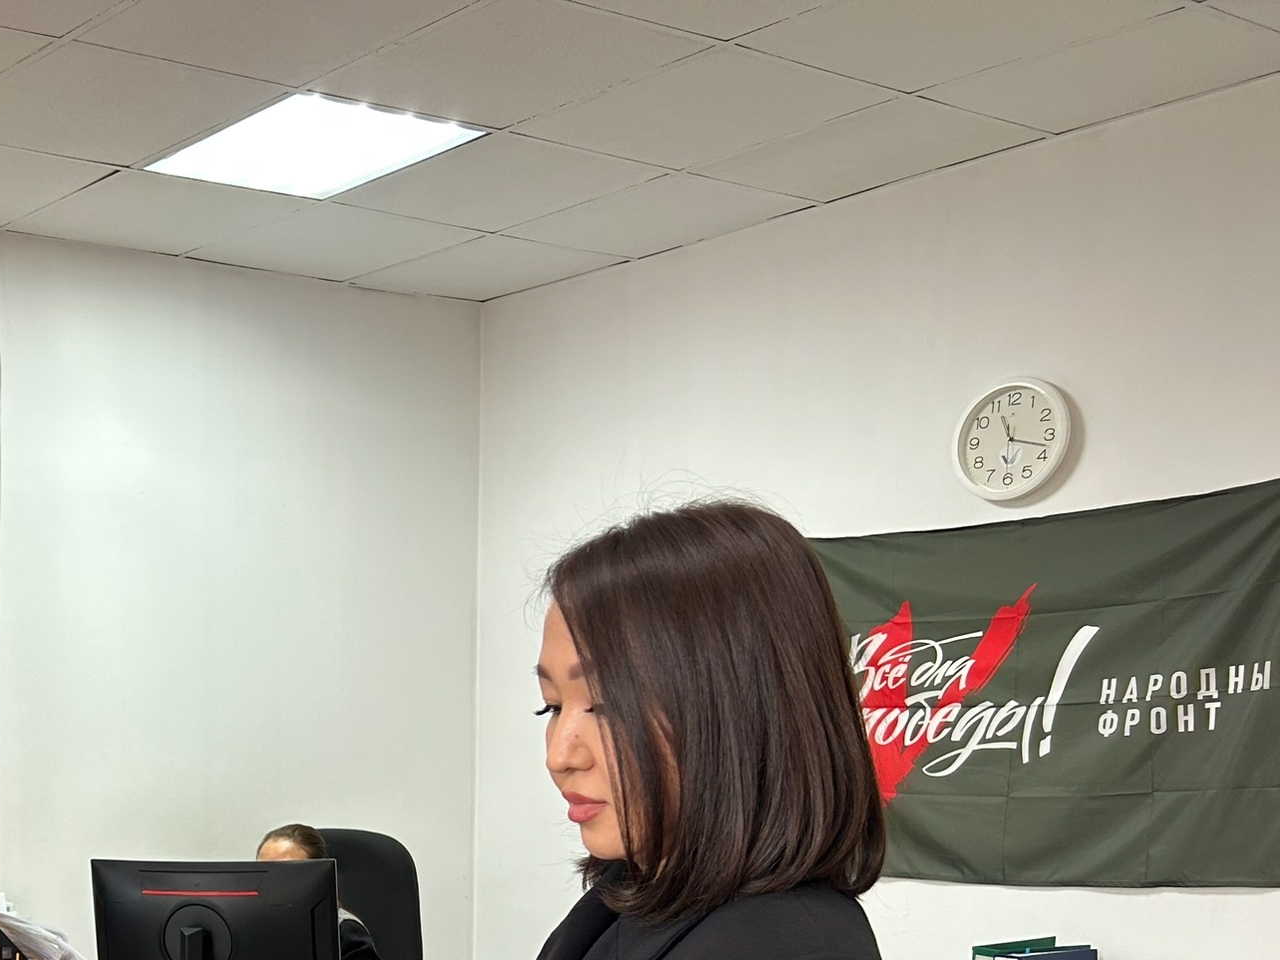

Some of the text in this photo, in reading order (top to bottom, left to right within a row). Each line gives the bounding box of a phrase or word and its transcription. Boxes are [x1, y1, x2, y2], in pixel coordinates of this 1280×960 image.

[1007, 392, 1022, 407] 12
[1031, 395, 1035, 408] 1
[991, 400, 1001, 414] 11
[1040, 408, 1051, 422] 2
[975, 416, 989, 430] 10
[1044, 428, 1055, 441] 3
[969, 437, 980, 450] 9
[973, 456, 984, 469] 8
[1037, 449, 1048, 462] 4
[986, 469, 996, 482] 7
[1002, 472, 1013, 486] 6
[1021, 465, 1033, 479] 5
[849, 632, 912, 703] Всё
[1098, 701, 1221, 738] ФРОНТ
